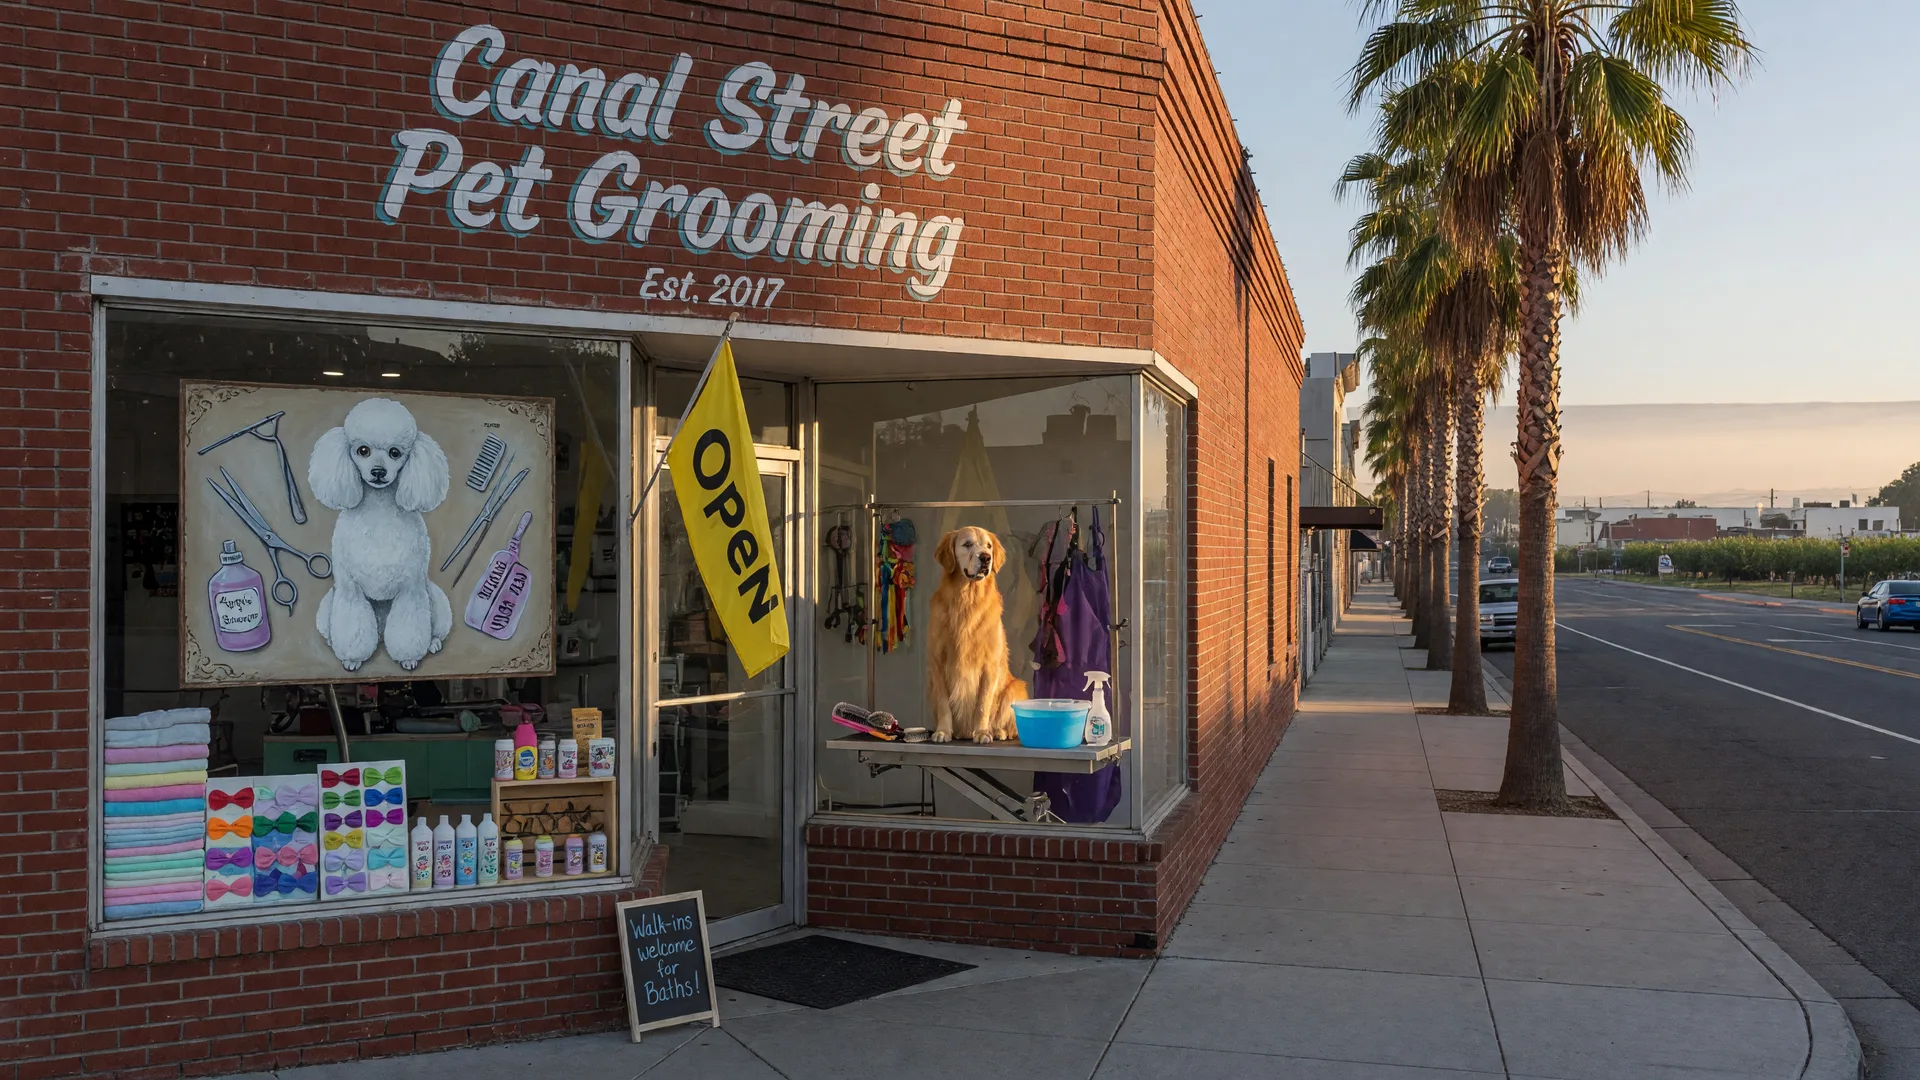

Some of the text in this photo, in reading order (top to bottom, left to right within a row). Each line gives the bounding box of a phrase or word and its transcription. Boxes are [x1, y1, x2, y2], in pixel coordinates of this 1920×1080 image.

[430, 24, 968, 180] Canal Street
[376, 128, 966, 302] Pet Grooming
[640, 268, 786, 310] Est. 2017
[629, 912, 693, 939] Walk-ins
[643, 969, 700, 1006] Baths!
[657, 958, 680, 978] for
